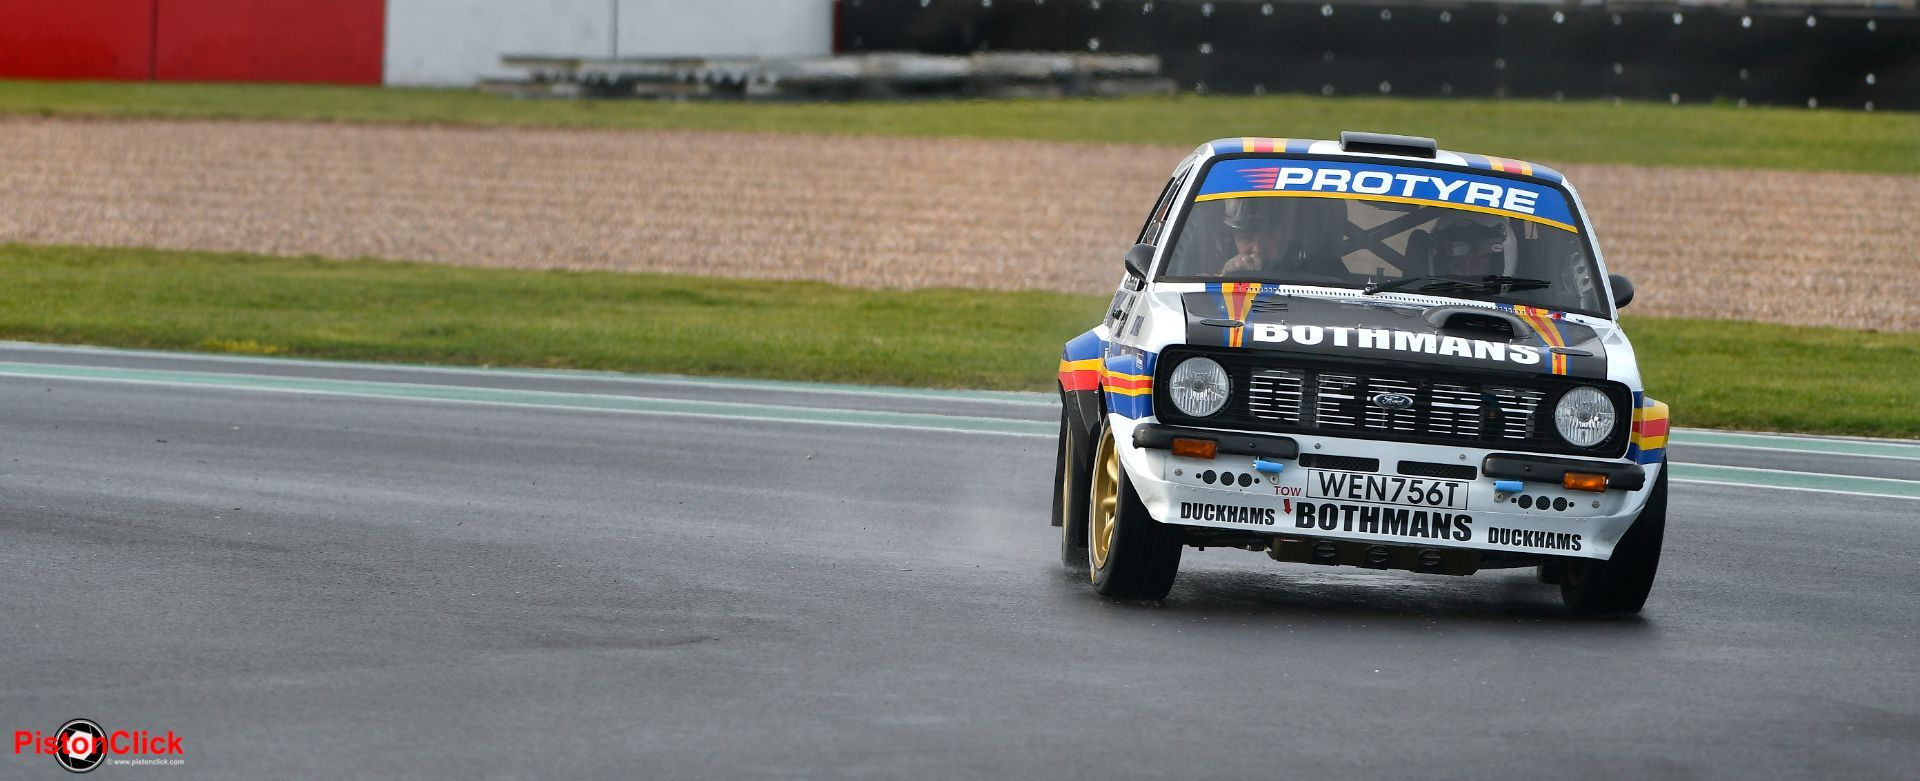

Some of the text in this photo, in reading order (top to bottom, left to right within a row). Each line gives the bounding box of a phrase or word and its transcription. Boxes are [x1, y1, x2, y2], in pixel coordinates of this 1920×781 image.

[1275, 167, 1538, 214] PROTYRE
[1252, 323, 1540, 365] BOTHMANS
[1274, 485, 1301, 496] TOW
[1180, 501, 1276, 525] DUCKHAMS
[1295, 502, 1472, 541] BOTHMANS
[1487, 526, 1583, 551] DUCKHAMS
